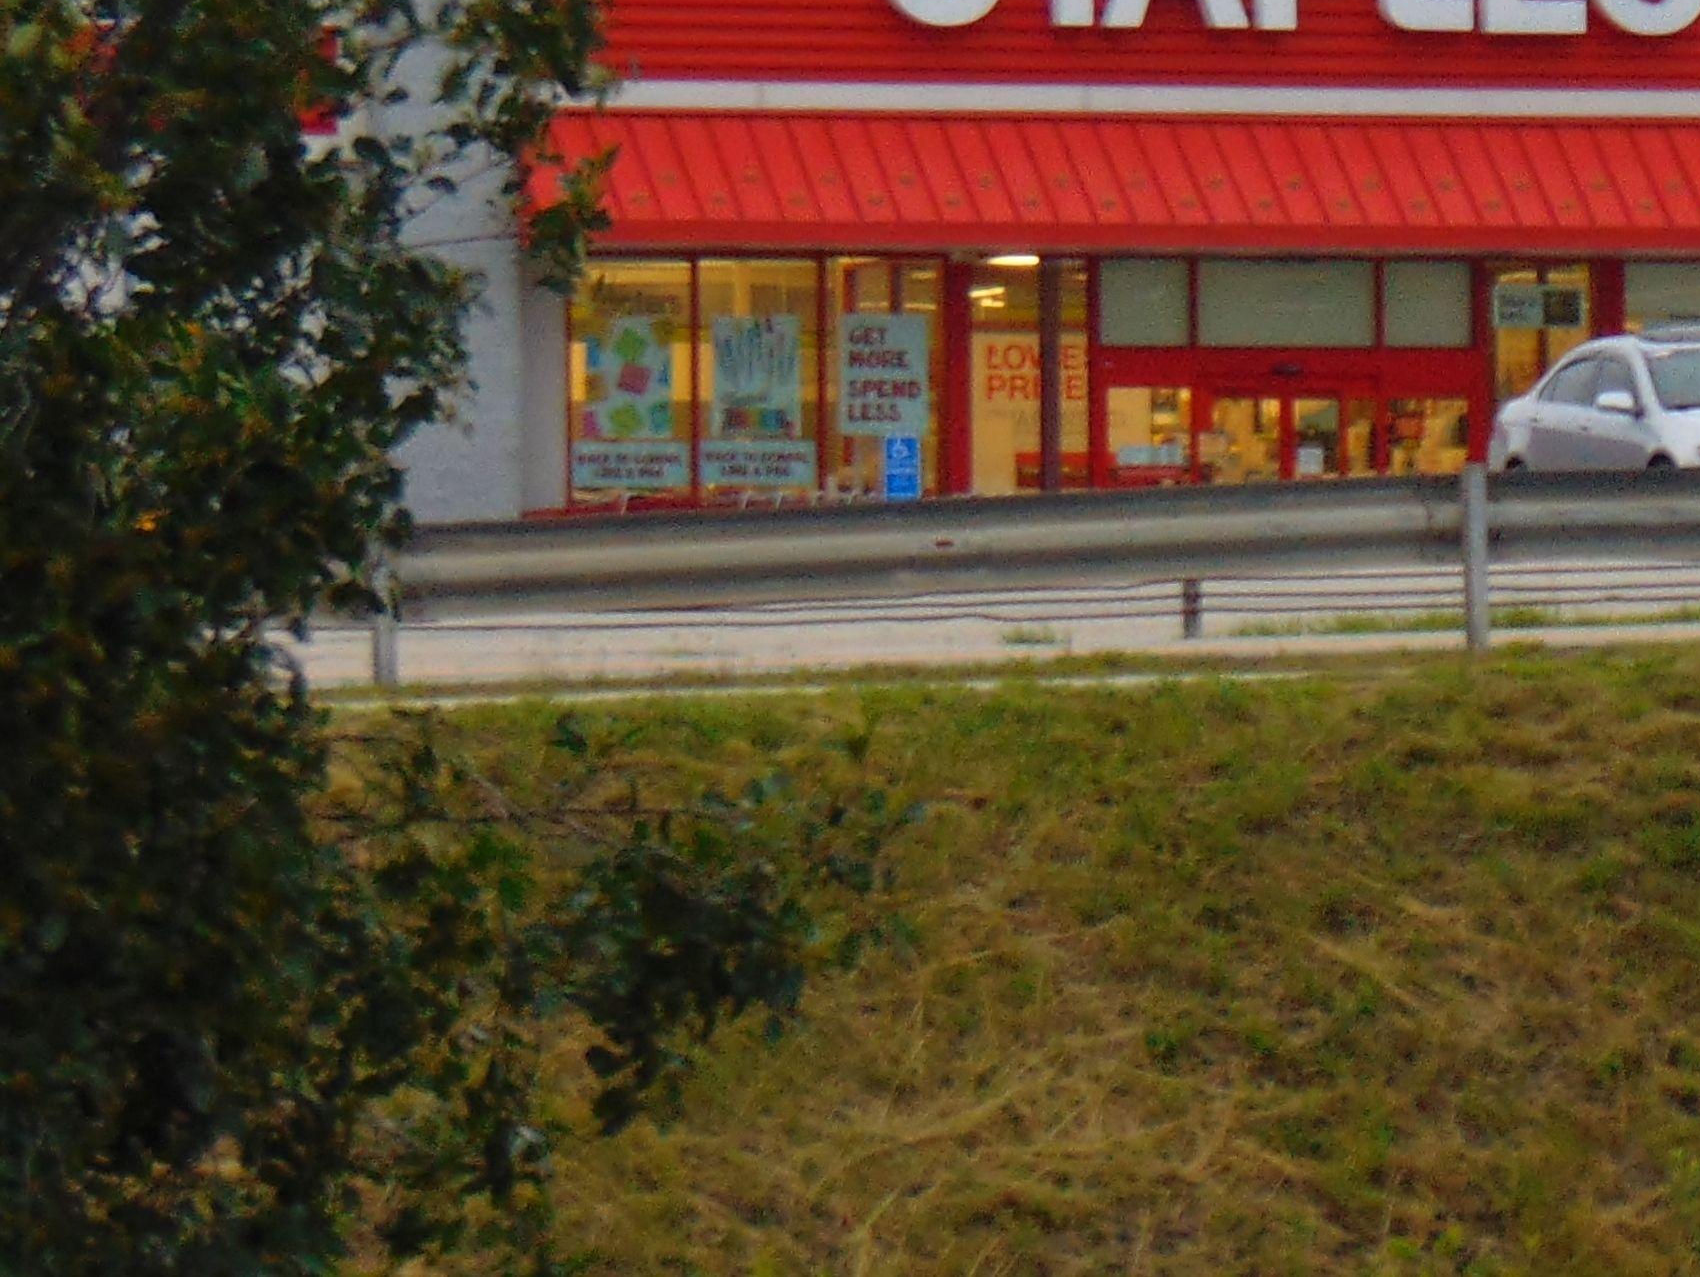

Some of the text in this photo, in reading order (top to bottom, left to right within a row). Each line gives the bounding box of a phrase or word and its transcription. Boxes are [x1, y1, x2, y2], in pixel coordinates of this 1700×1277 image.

[849, 327, 887, 345] GET
[849, 350, 909, 368] MORE
[848, 380, 922, 399] SPEND
[848, 403, 901, 422] LESS
